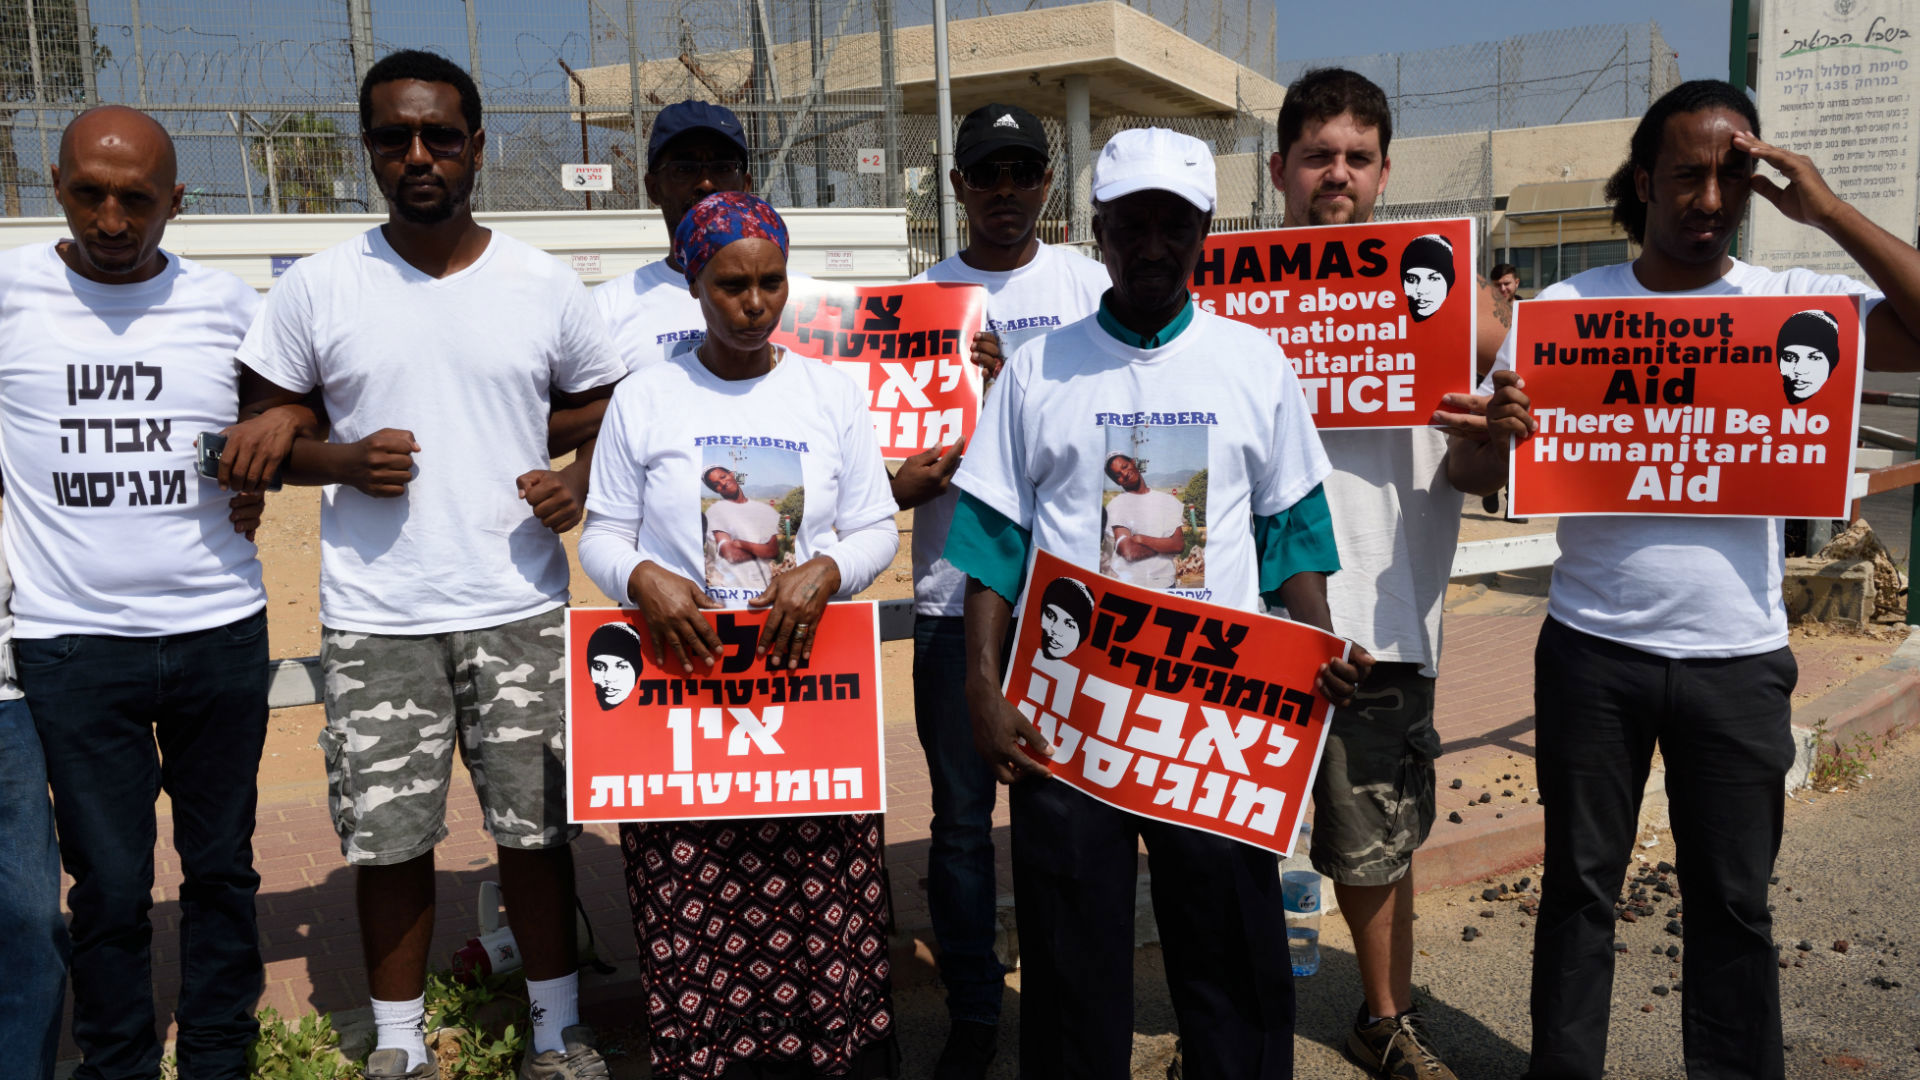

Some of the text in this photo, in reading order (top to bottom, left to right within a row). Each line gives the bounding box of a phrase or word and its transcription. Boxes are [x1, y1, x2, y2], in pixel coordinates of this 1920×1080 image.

[1782, 16, 1911, 56] בשביל הבריאות
[1775, 59, 1909, 81] סיימת מסלול הליכה
[1816, 79, 1849, 91] 1.435
[1855, 75, 1899, 90] במרחק
[872, 155, 880, 166] 2
[1193, 238, 1388, 286] HAMAS
[781, 294, 903, 332] צדק
[1225, 289, 1290, 316] NOT
[1299, 287, 1396, 313] above
[656, 329, 700, 344] FREE
[1007, 315, 1061, 331] ABERA
[1574, 310, 1734, 339] Without
[797, 329, 965, 359] הומניטרי
[1534, 338, 1773, 366] Humanitarian
[67, 361, 163, 406] למען
[1602, 365, 1696, 405] Aid
[1095, 411, 1219, 426] FREE ABERA
[1534, 406, 1830, 434] There Will Be No
[60, 418, 173, 454] אברה
[694, 435, 810, 453] FREE ABERA
[1534, 435, 1827, 464] Humanitarian
[52, 470, 187, 507] מנגיסטו
[1626, 463, 1721, 502] Aid
[1090, 592, 1250, 669] צדק
[638, 673, 861, 706] הומניטריות
[1108, 645, 1315, 727] הומניטרי
[1026, 647, 1300, 776] לאברה
[667, 705, 786, 772] אין
[589, 767, 864, 808] הומניטריות
